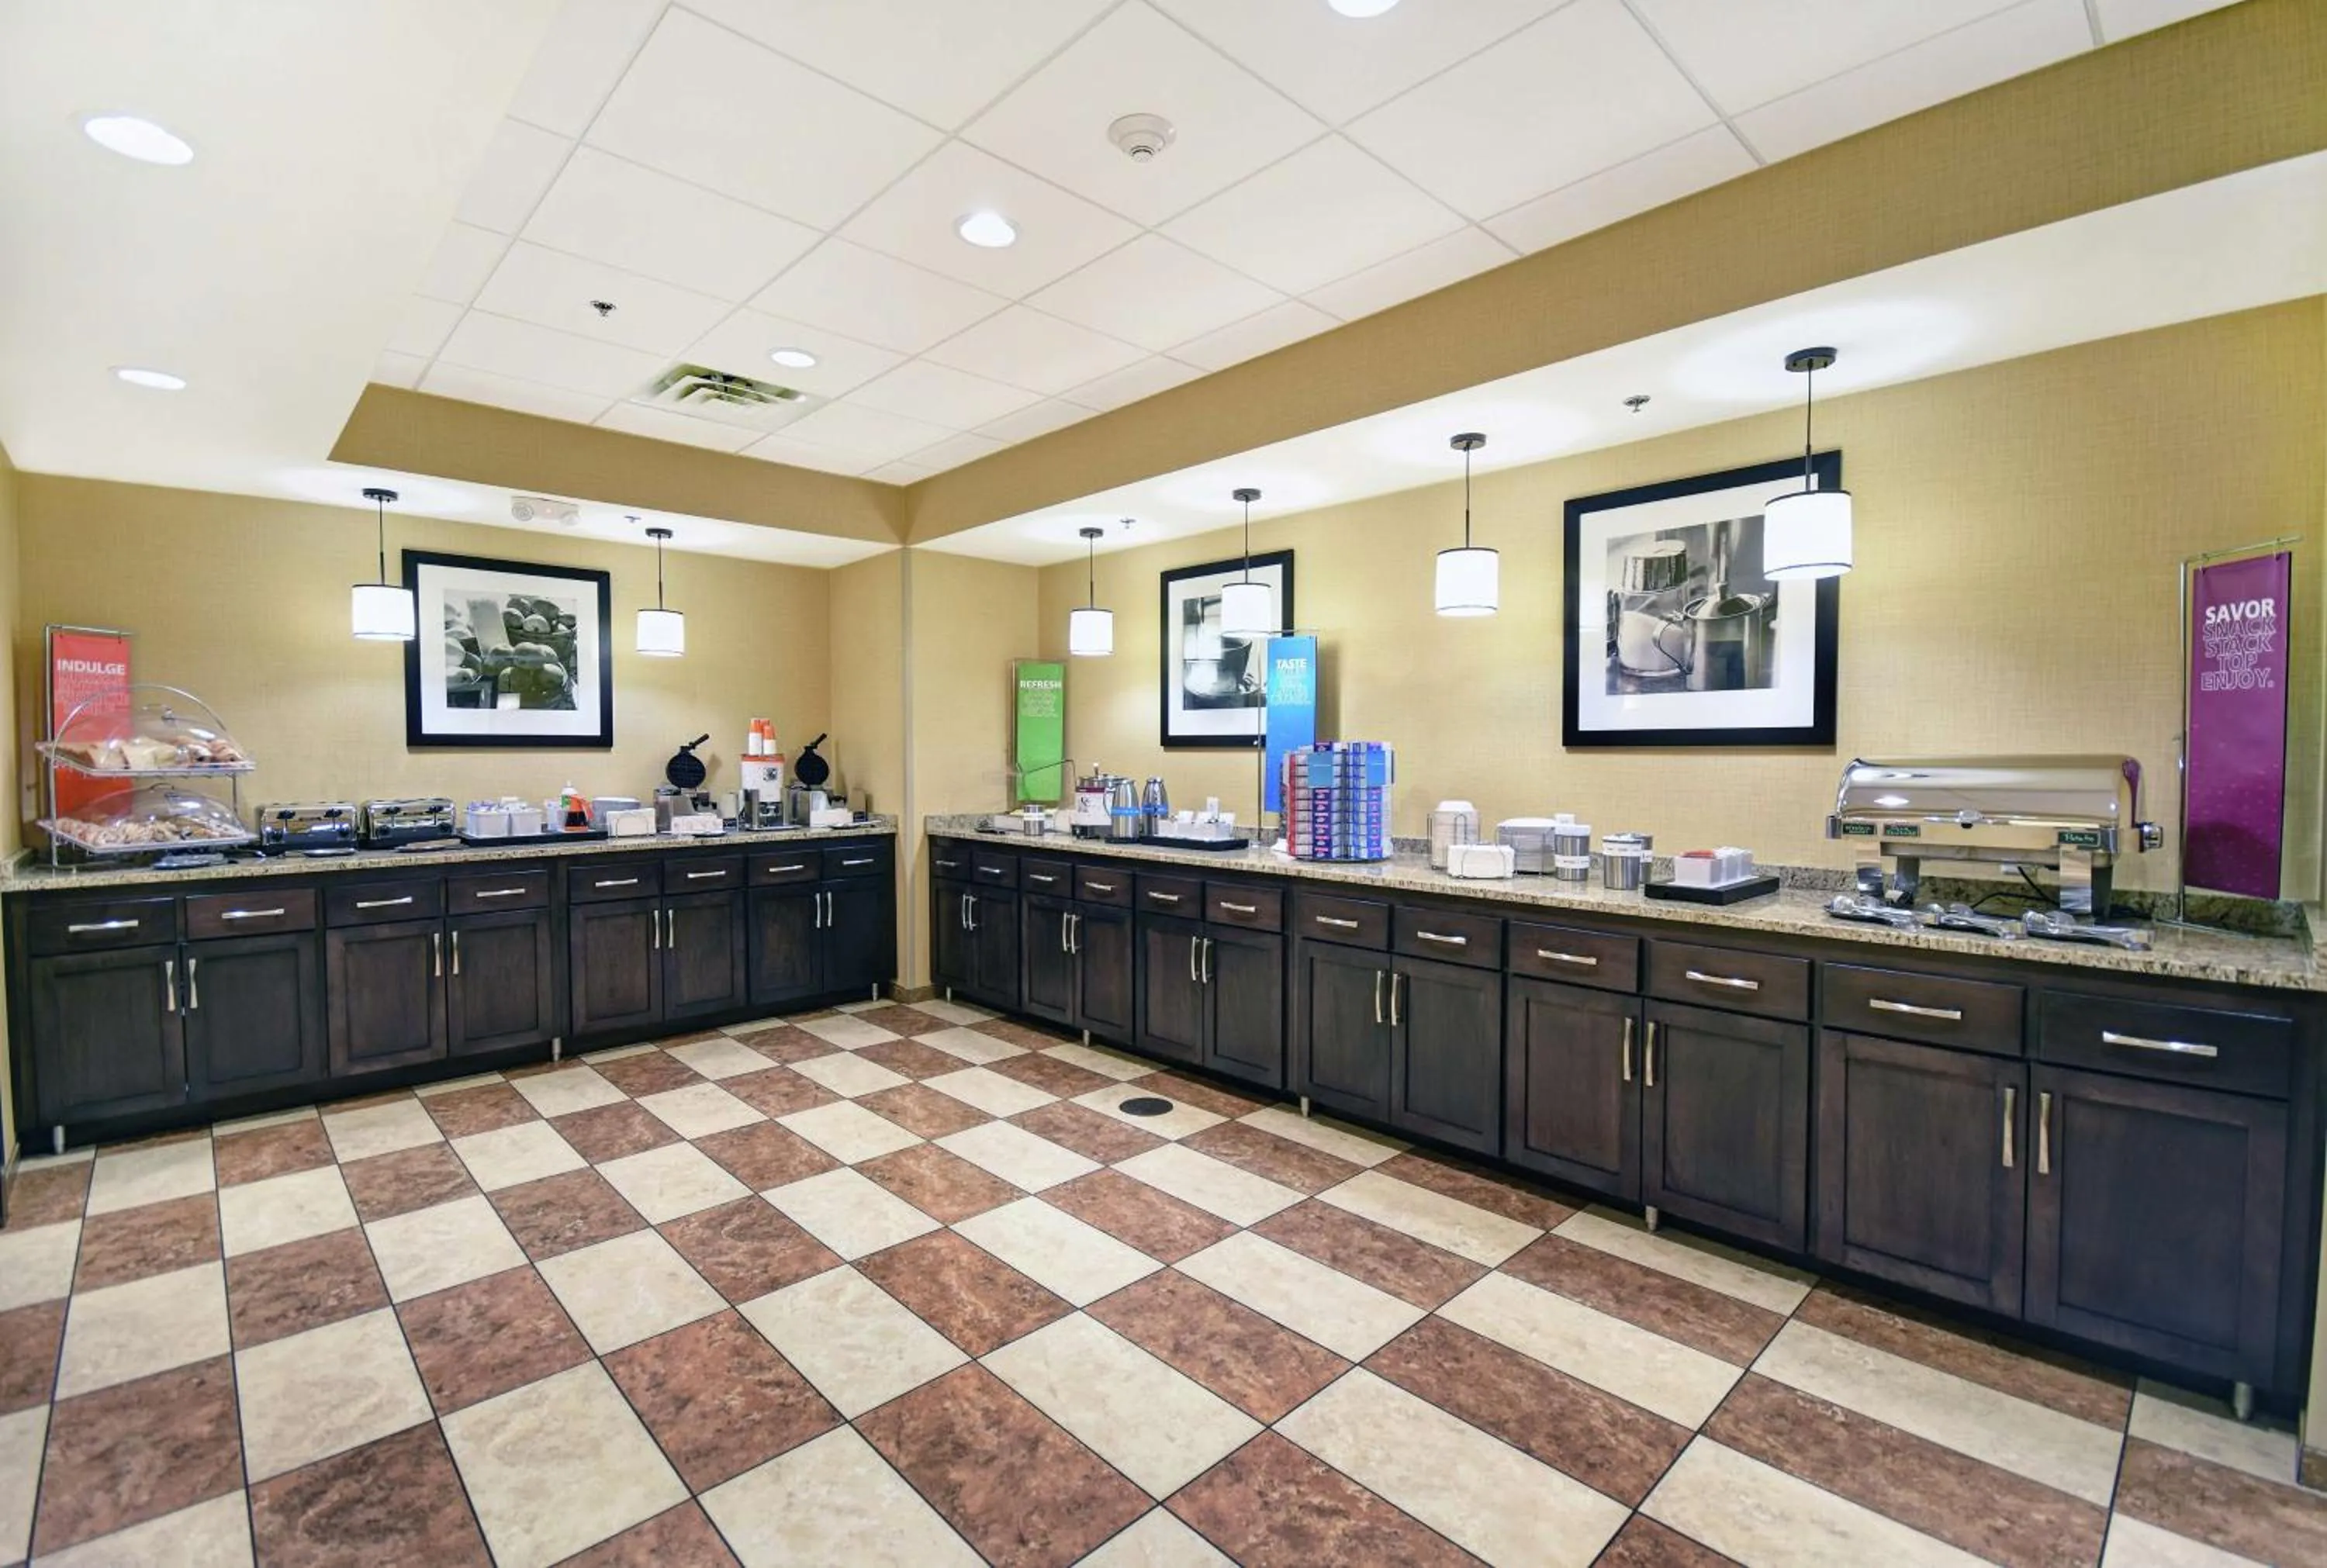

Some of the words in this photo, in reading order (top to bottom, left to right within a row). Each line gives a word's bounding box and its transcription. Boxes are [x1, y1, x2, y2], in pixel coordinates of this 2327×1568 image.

[2205, 598, 2276, 625] SAVOR
[2203, 614, 2277, 641] SNACK
[2204, 633, 2273, 658] STACK
[57, 658, 126, 675] INDULGE
[1277, 658, 1307, 668] TASTE
[2217, 651, 2259, 672] TOP
[1019, 679, 1062, 689] REFRESH
[2201, 668, 2275, 691] ENJOY.
